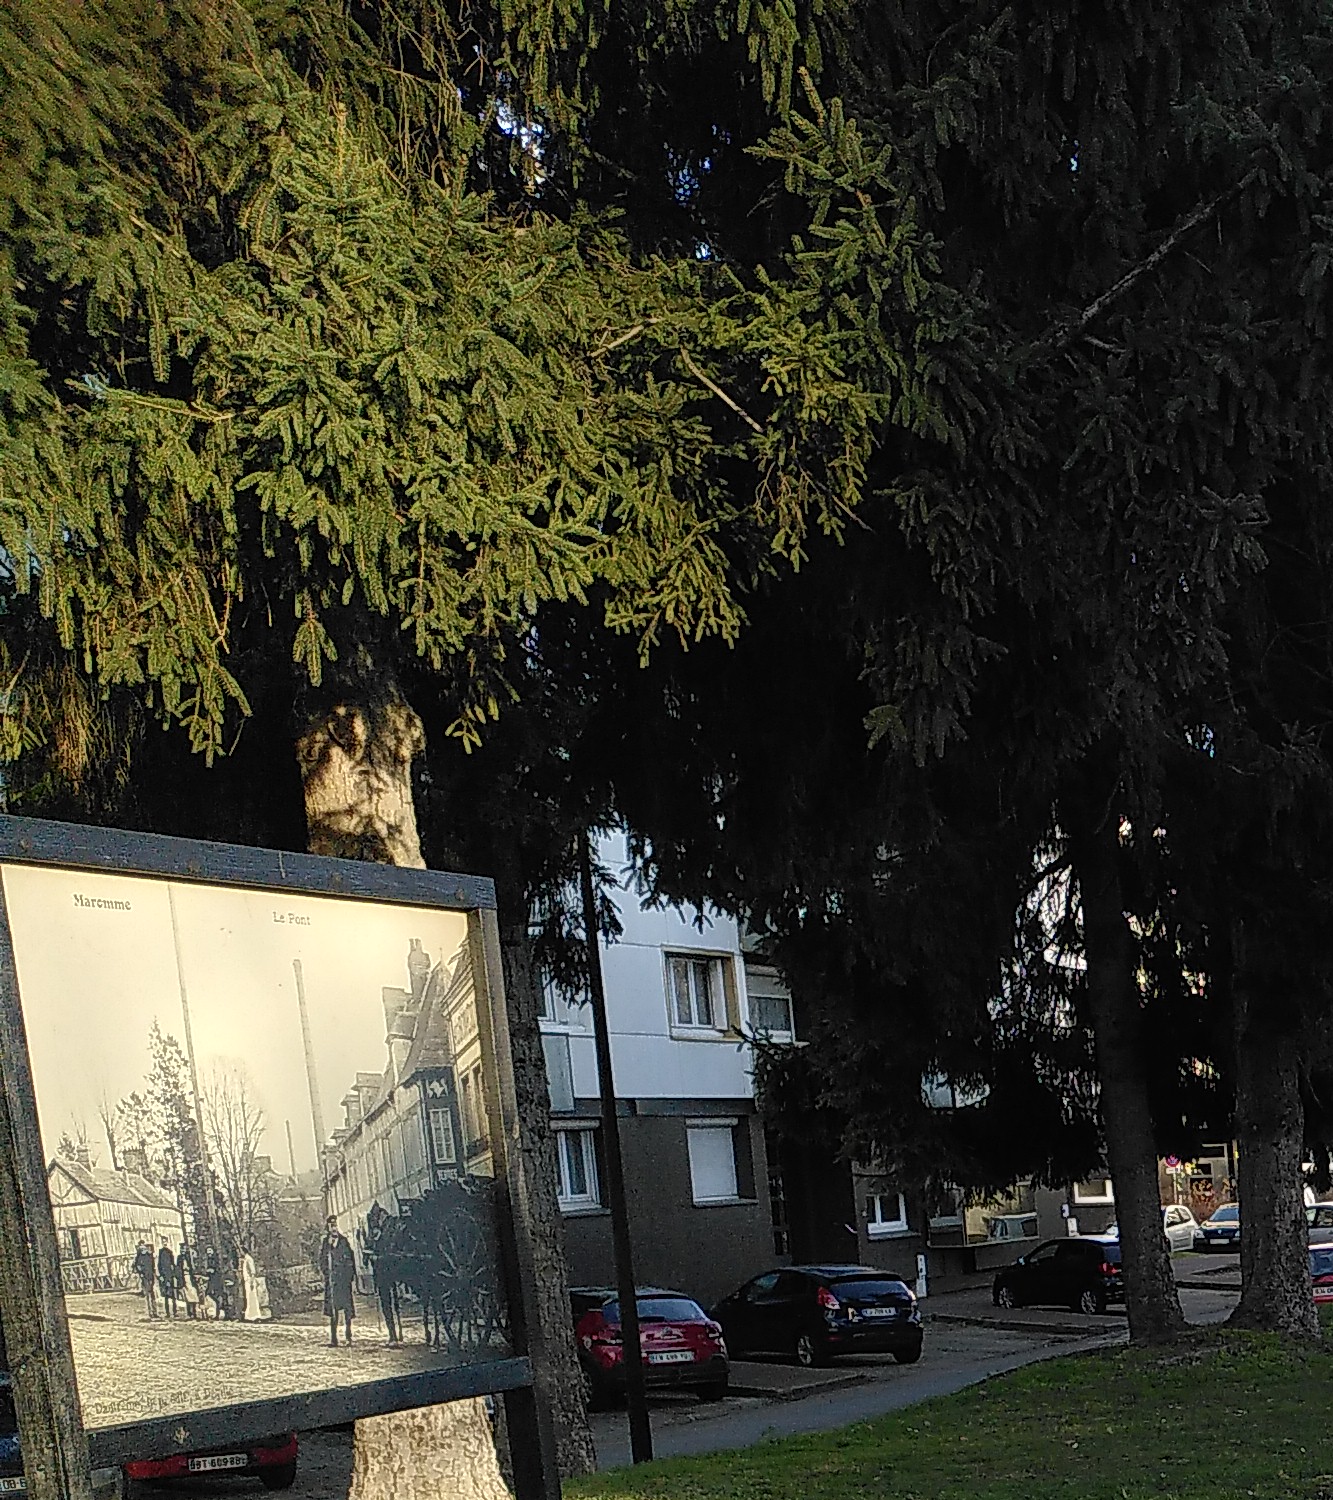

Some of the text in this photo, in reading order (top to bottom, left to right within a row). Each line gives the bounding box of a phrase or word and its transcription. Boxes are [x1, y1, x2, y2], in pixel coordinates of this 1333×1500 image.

[73, 893, 133, 911] Maromme
[272, 910, 312, 927] Le Pont
